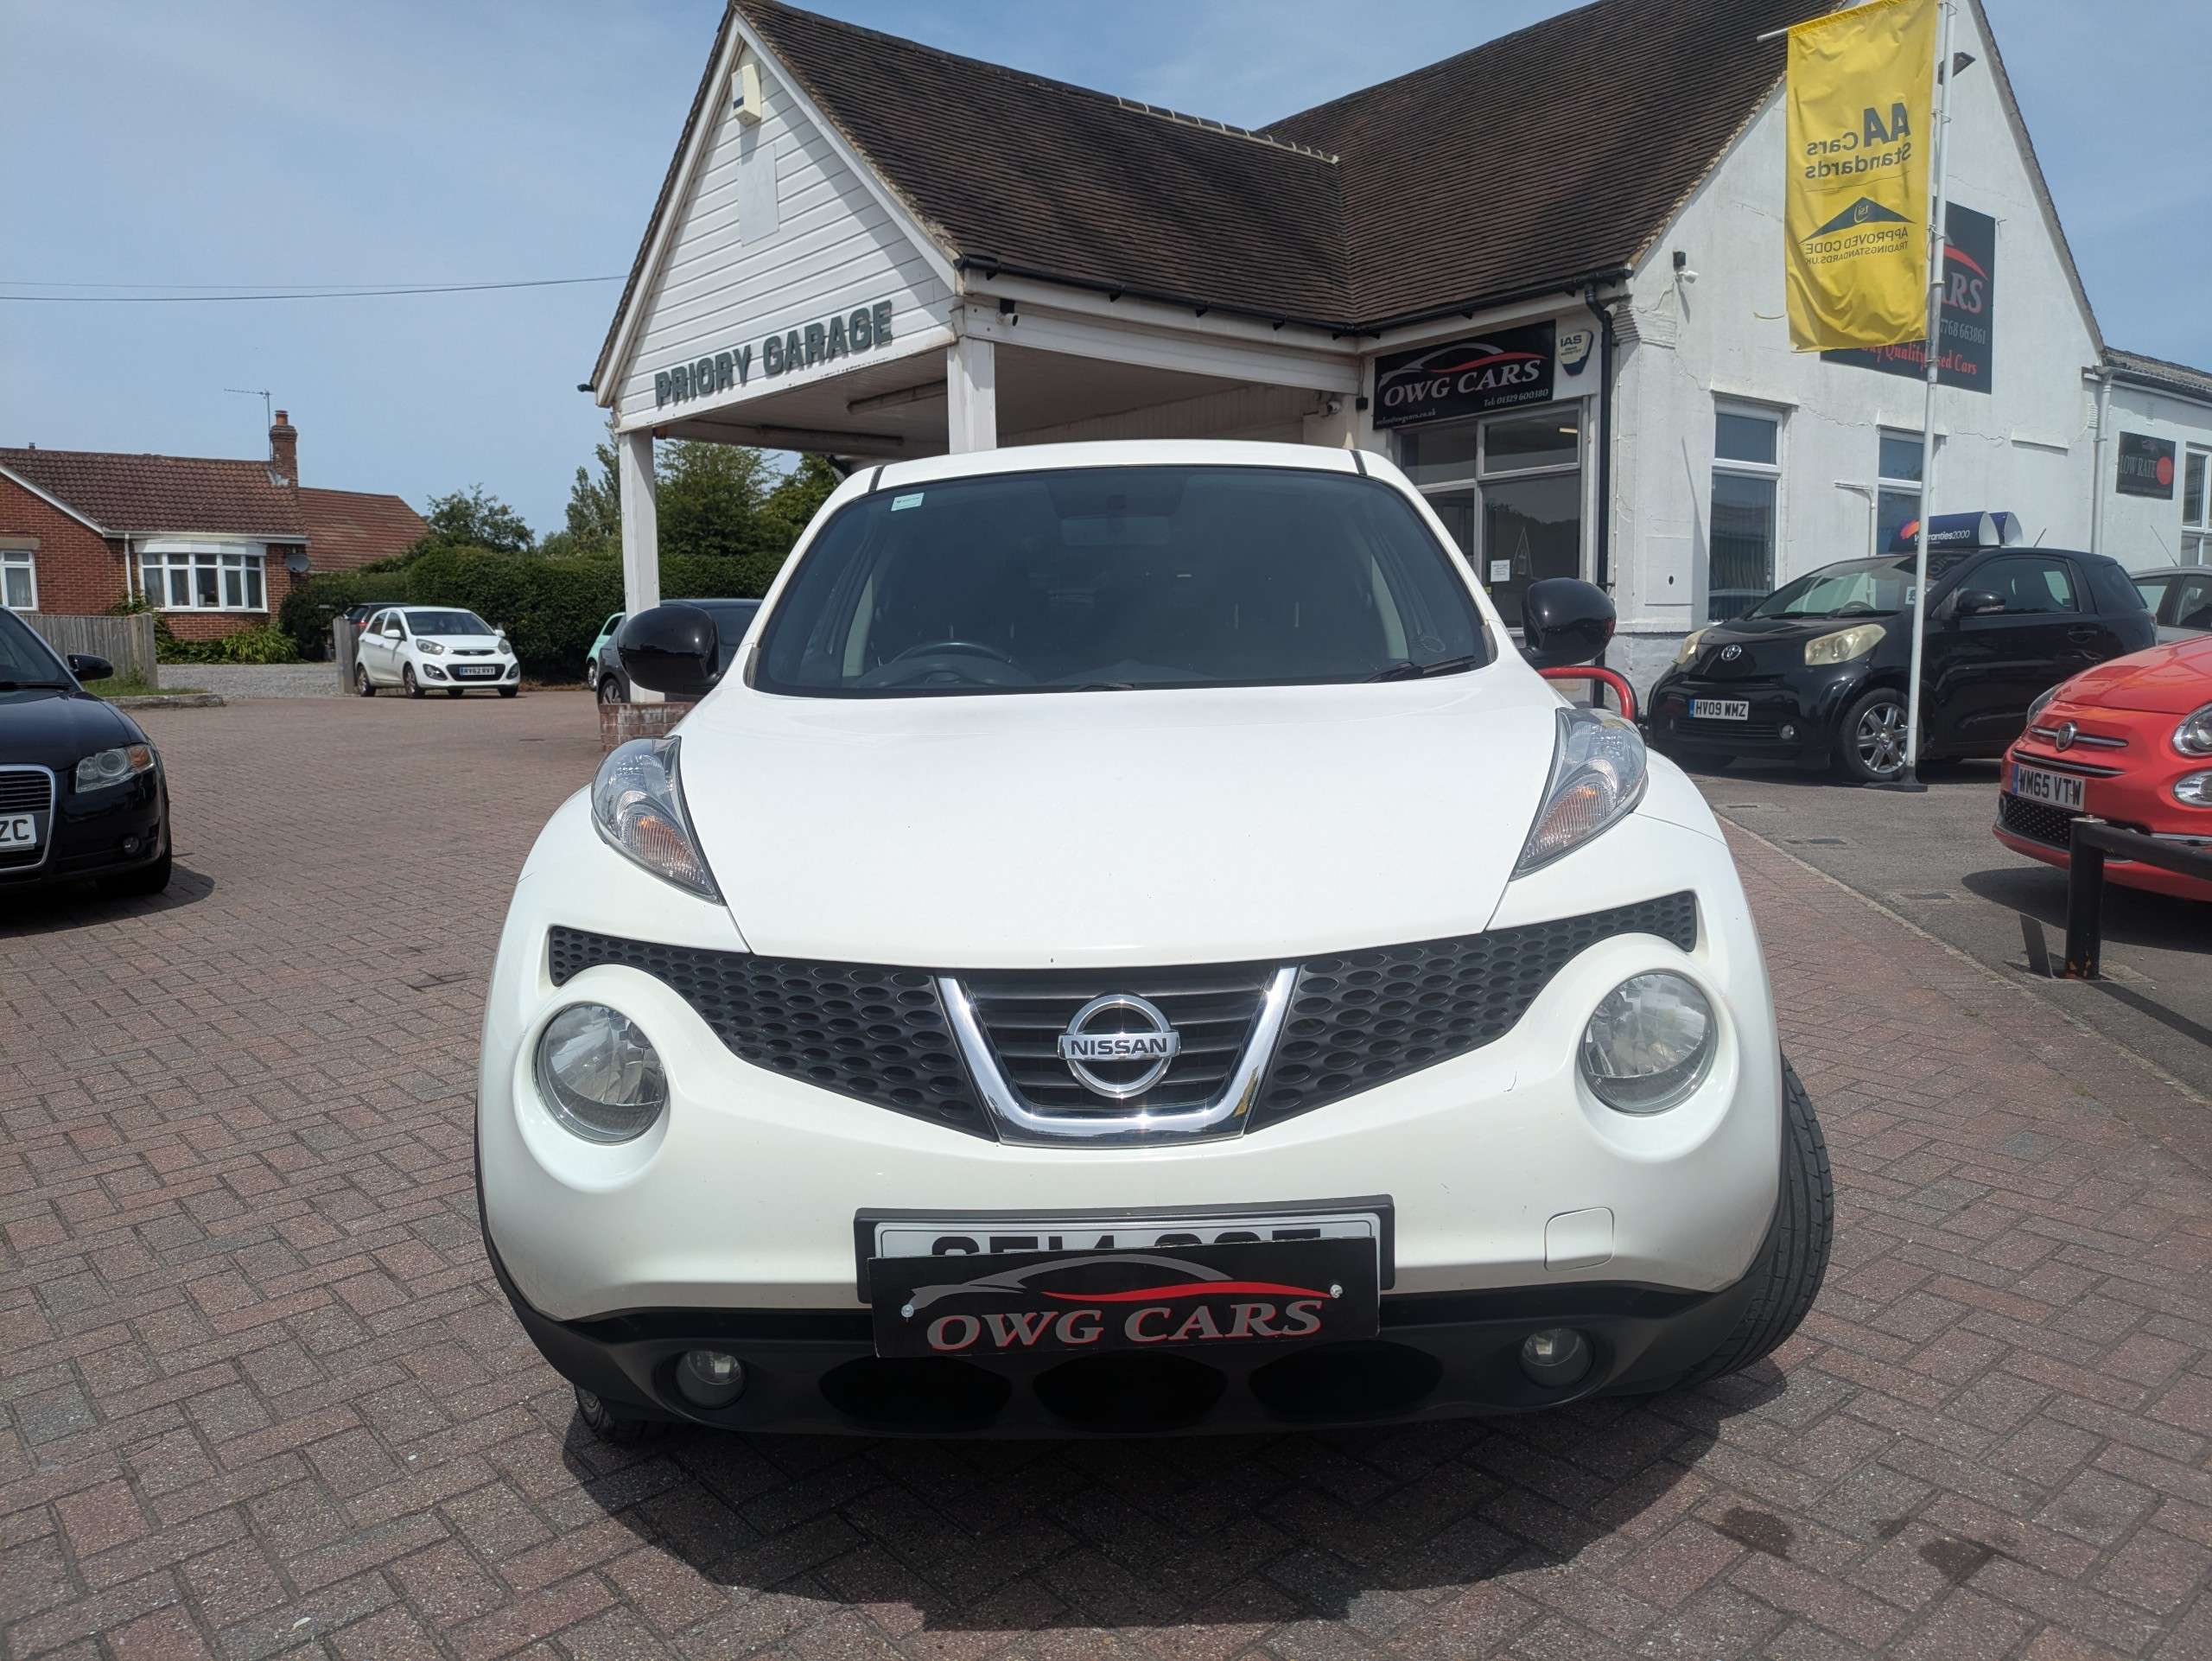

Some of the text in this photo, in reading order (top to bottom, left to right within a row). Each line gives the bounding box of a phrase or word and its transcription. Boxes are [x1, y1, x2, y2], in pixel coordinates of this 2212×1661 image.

[1941, 270, 1984, 315] RS
[1560, 334, 1582, 347] IAS
[1940, 317, 1959, 337] 7768
[654, 300, 893, 409] PRIORY GARAGE
[1937, 350, 1953, 369] sed
[1955, 353, 1978, 374] Cars
[1383, 360, 1541, 407] OWG CARS
[1695, 702, 1746, 717] HV09 WMZ
[2018, 767, 2082, 805] WM65 VTW
[1071, 1038, 1166, 1055] NISSAN
[926, 1301, 1323, 1350] OWG CARS
